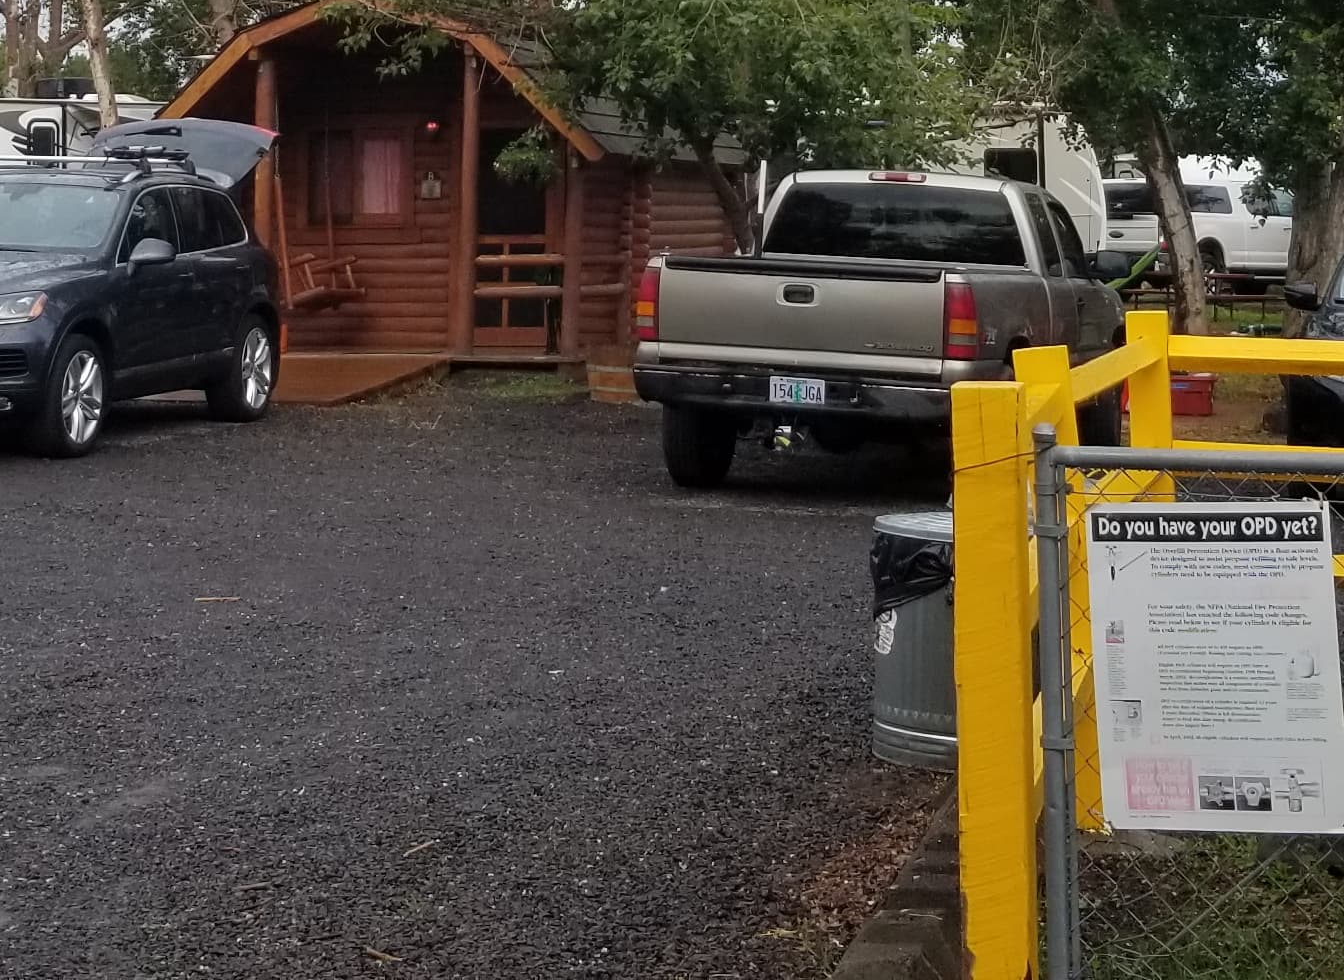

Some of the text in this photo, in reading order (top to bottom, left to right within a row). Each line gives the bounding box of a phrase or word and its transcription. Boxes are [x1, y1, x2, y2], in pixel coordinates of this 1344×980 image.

[773, 383, 822, 402] 154 JGA
[1098, 516, 1317, 539] Do you have your OPD yet?
